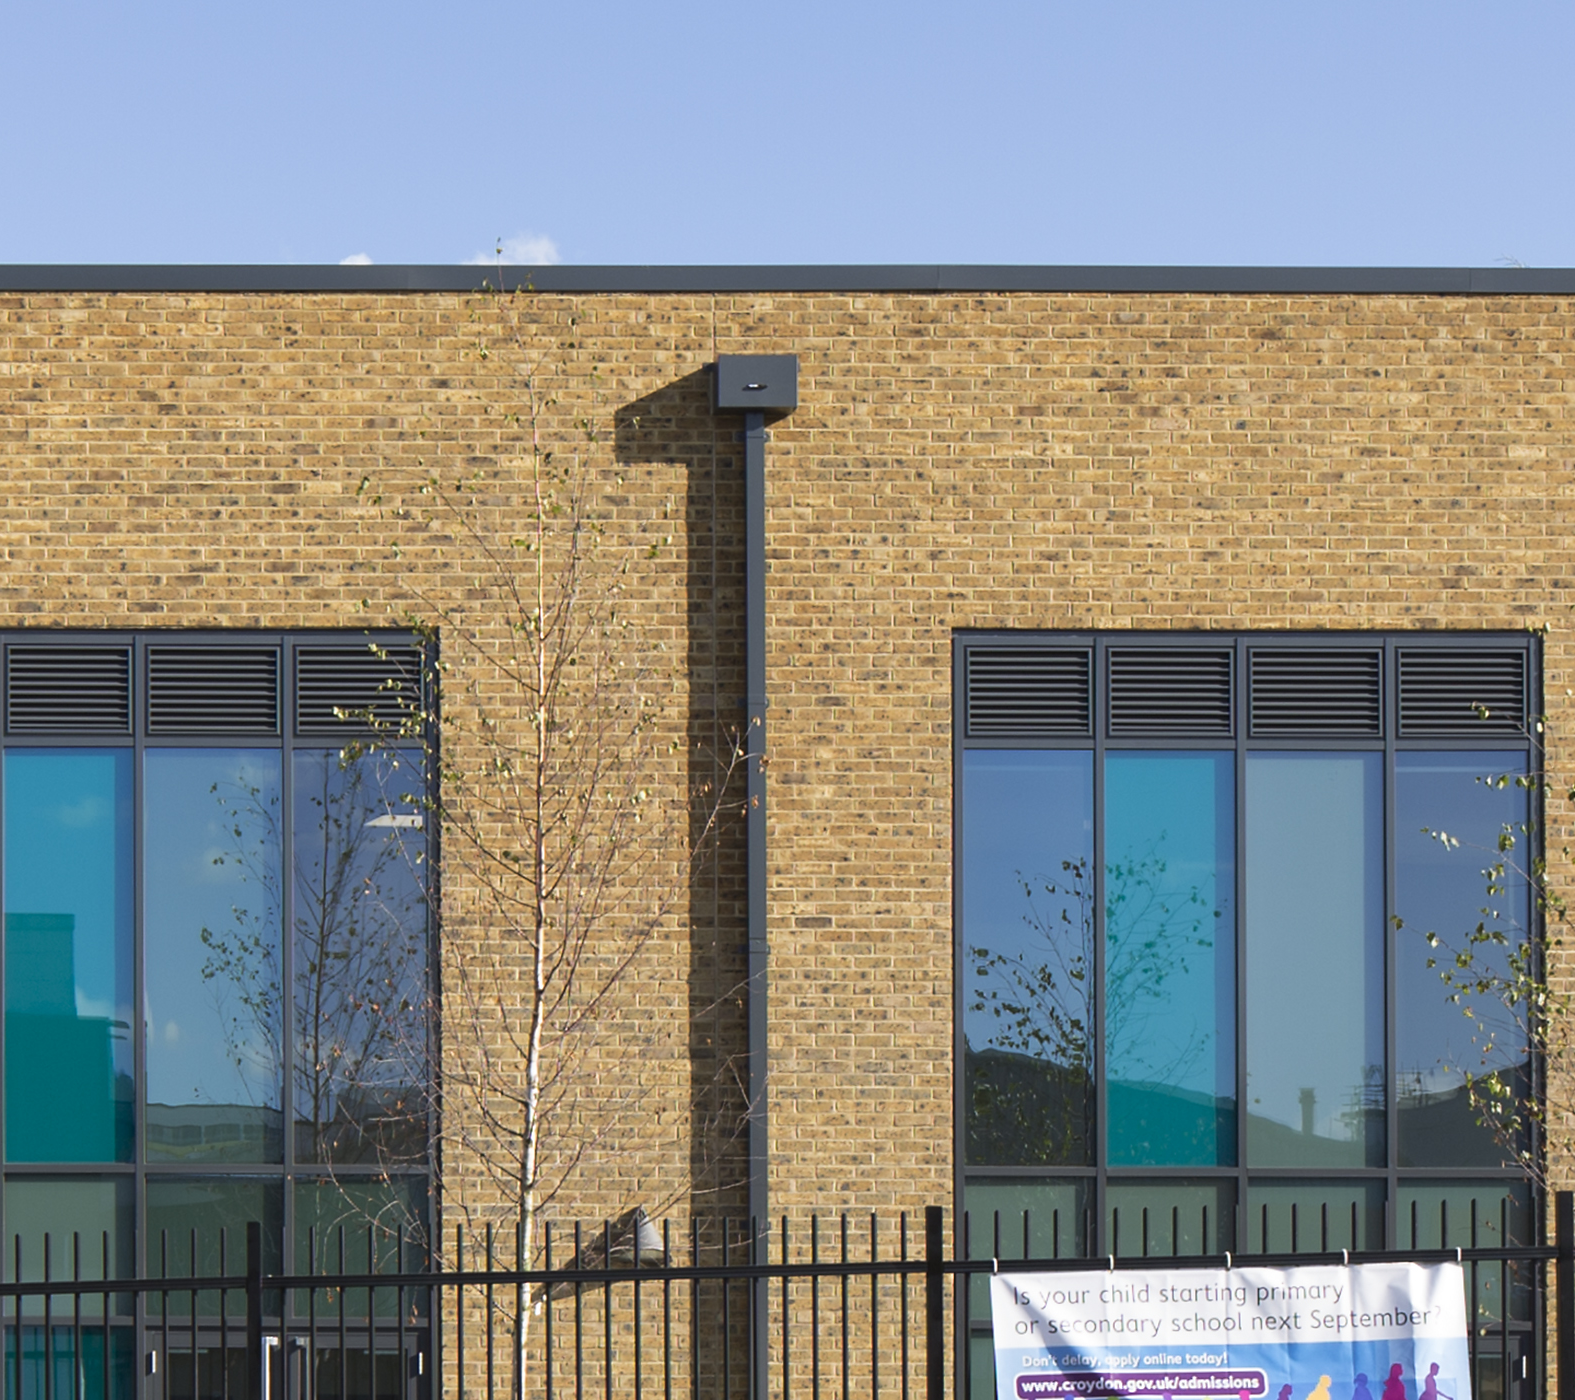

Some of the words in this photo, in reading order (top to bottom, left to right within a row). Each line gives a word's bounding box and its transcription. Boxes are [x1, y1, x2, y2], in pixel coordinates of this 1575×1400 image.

[1013, 1286, 1031, 1305] Is
[1039, 1289, 1090, 1310] your
[1099, 1284, 1149, 1304] child
[1159, 1282, 1247, 1307] starting
[1256, 1282, 1345, 1306] primary
[1015, 1319, 1039, 1335] or
[1048, 1314, 1162, 1338] secondary
[1172, 1311, 1242, 1332] school
[1252, 1314, 1301, 1331] next
[1310, 1305, 1441, 1333] September?
[1022, 1354, 1057, 1367] Don't
[1061, 1354, 1101, 1368] delay,
[1105, 1354, 1140, 1368] apply
[1143, 1353, 1182, 1365] online
[1186, 1352, 1228, 1365] today!
[1021, 1375, 1260, 1393] www.croydon.gov.uk/admissions
